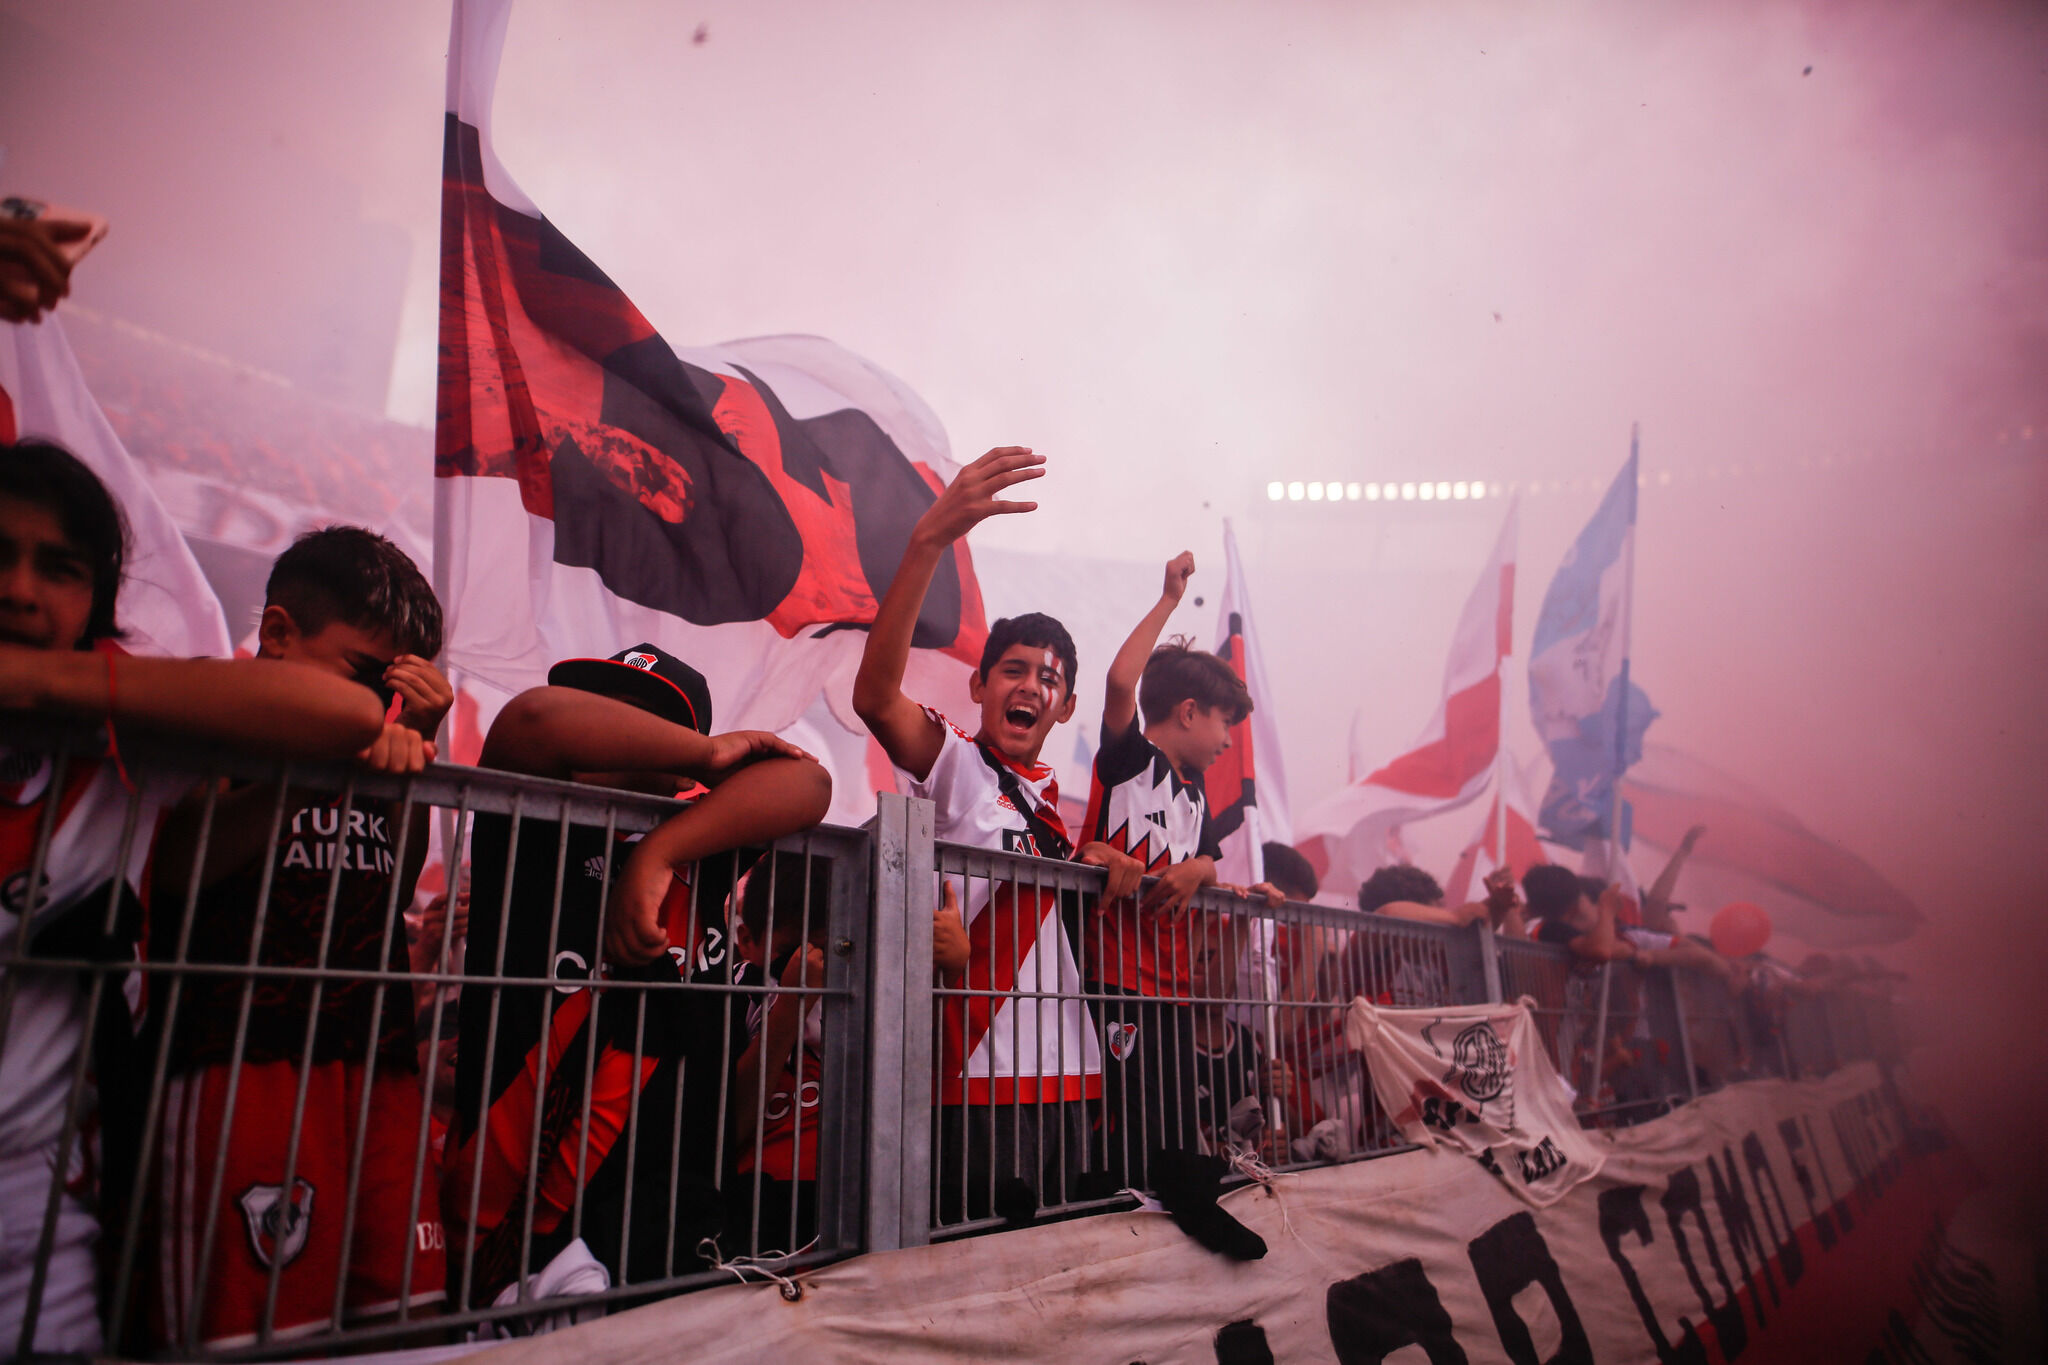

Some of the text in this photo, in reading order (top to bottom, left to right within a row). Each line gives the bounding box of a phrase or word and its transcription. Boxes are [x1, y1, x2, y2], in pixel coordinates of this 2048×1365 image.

[291, 807, 392, 844] TURK
[1597, 1130, 1804, 1365] COMO
[1777, 1113, 1856, 1251] EL
